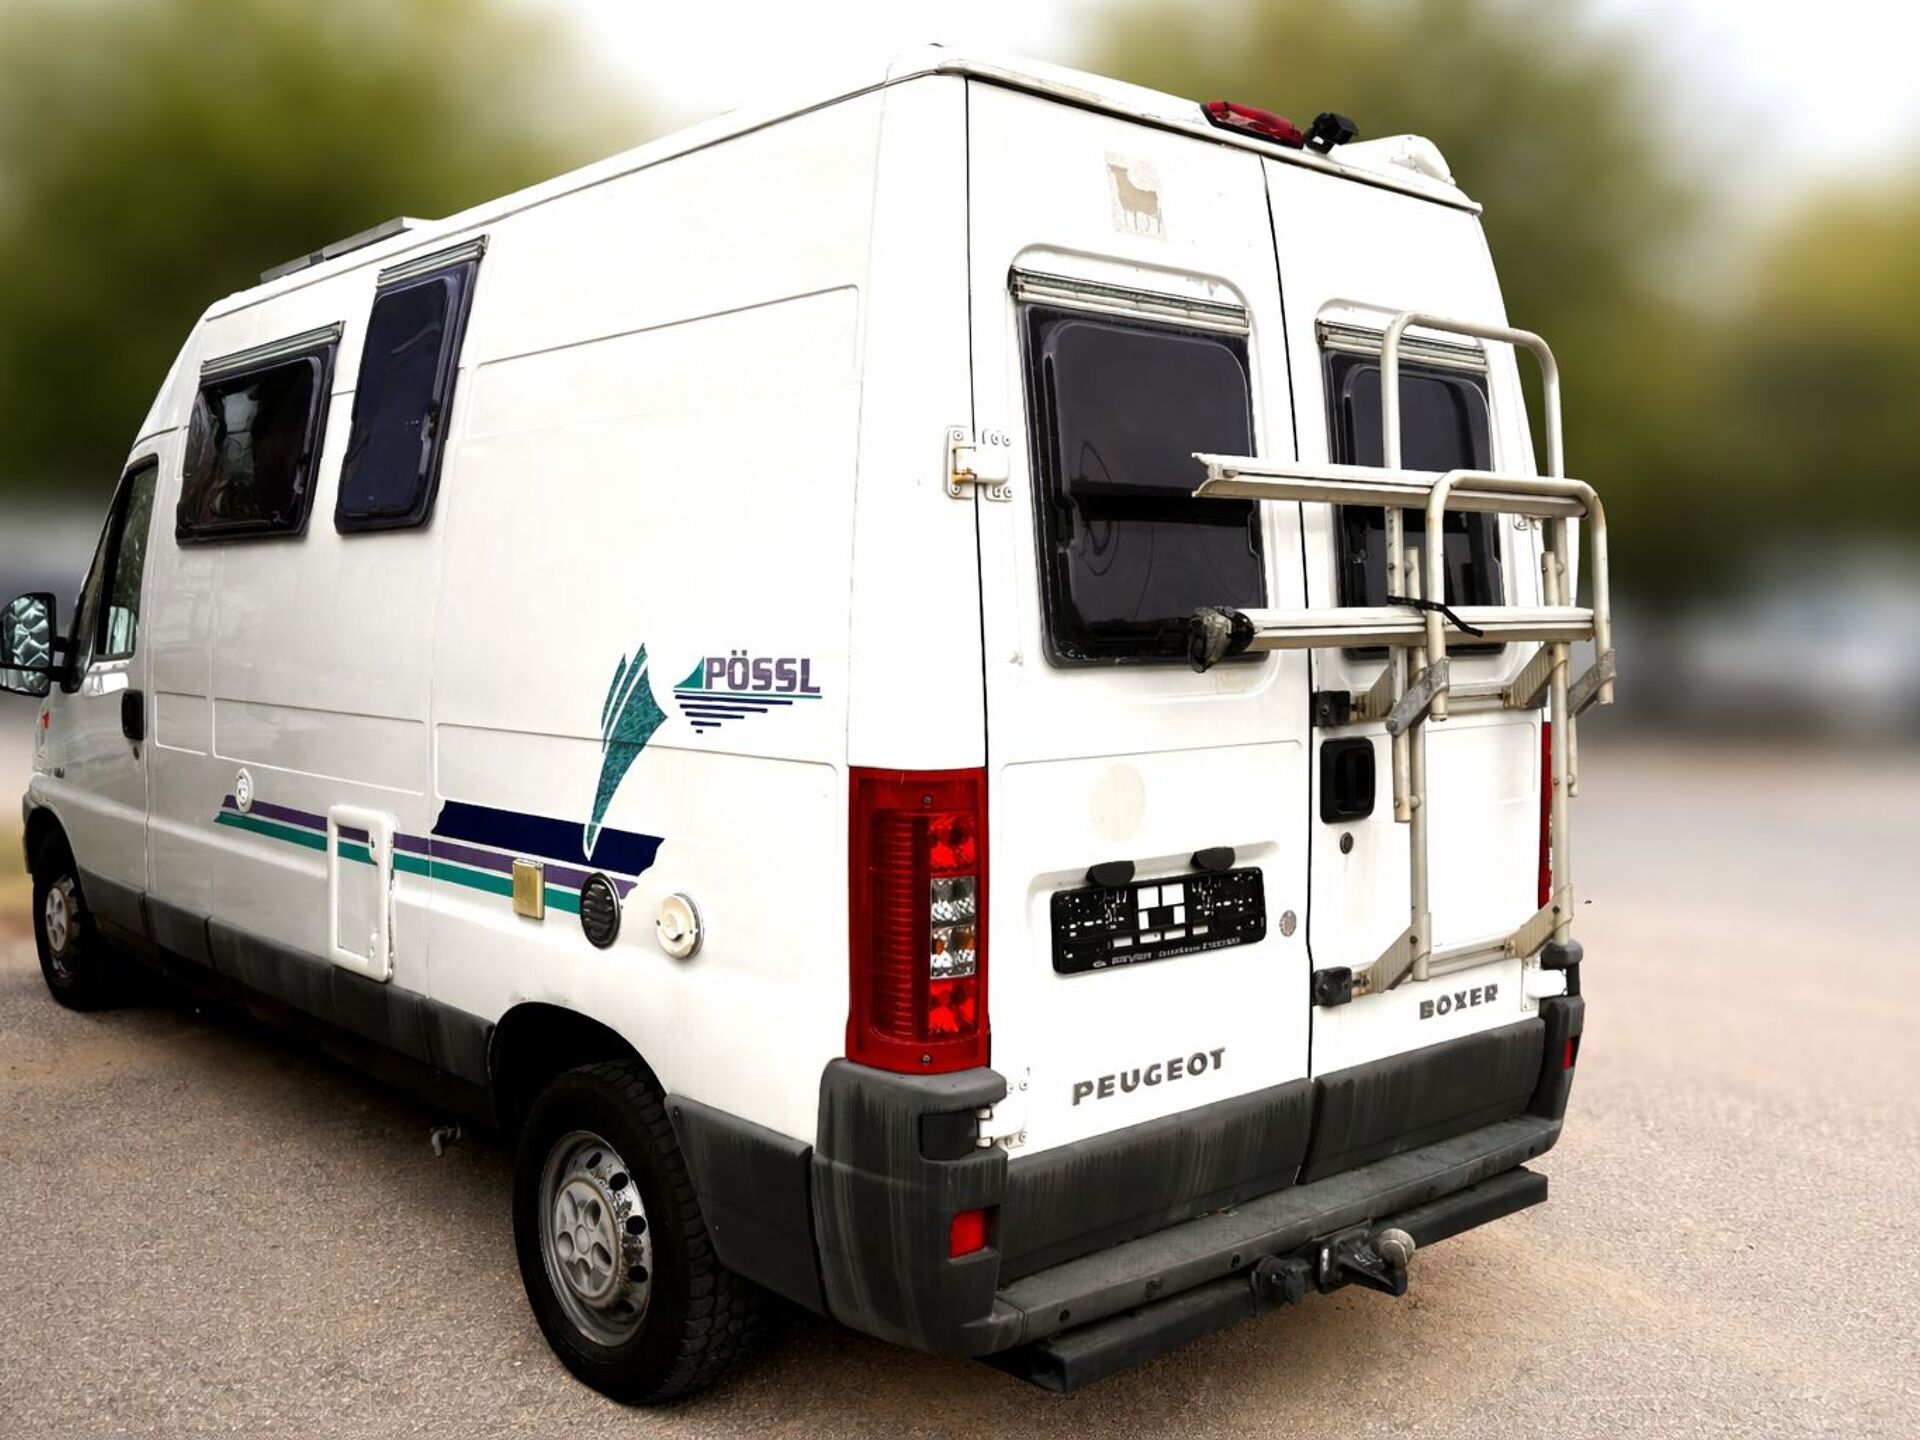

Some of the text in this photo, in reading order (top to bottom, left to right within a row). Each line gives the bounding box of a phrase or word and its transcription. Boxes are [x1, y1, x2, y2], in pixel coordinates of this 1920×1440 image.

[705, 649, 821, 694] PÖSSL
[1419, 983, 1499, 1020] BOXER
[1072, 1046, 1226, 1106] PEUGEOT
